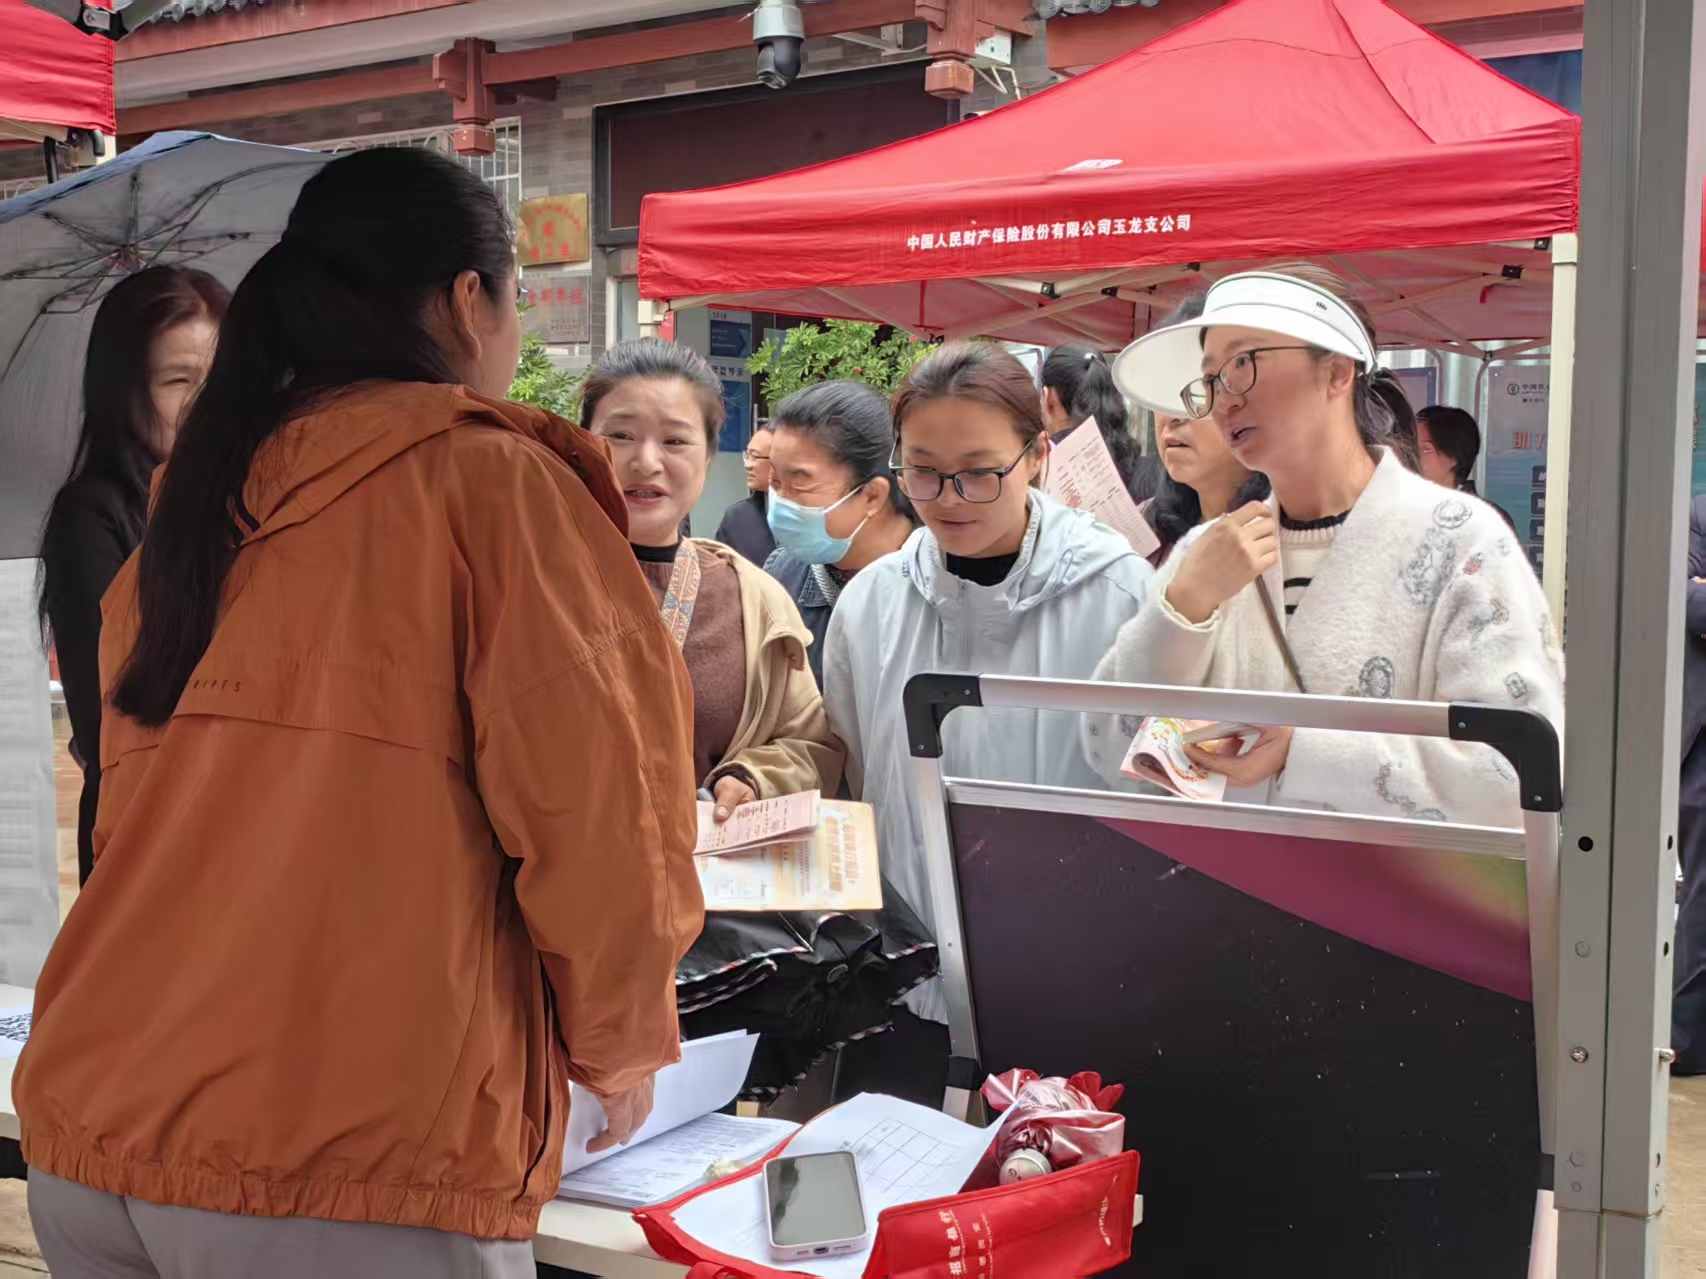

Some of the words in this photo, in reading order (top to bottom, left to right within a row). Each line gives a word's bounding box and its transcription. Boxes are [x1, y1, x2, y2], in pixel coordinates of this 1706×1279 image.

[906, 214, 1192, 252] 中国人民财产保险股份有限公司玉龙支公司
